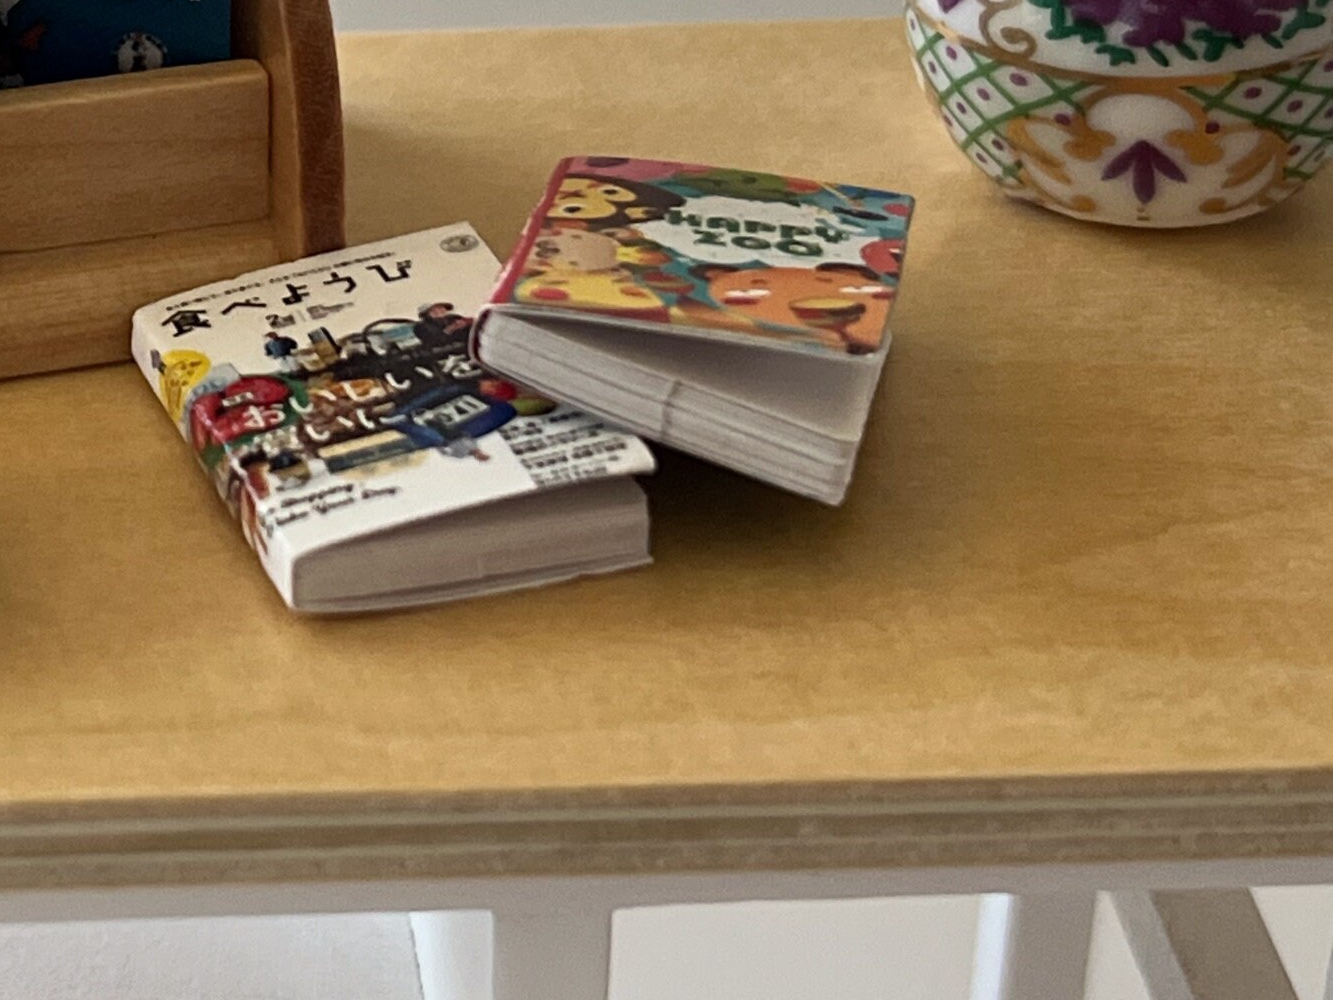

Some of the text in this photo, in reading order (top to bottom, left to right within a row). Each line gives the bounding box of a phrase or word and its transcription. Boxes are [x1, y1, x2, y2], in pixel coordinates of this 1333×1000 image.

[692, 227, 824, 257] ZOO
[160, 258, 414, 338] 食べようび
